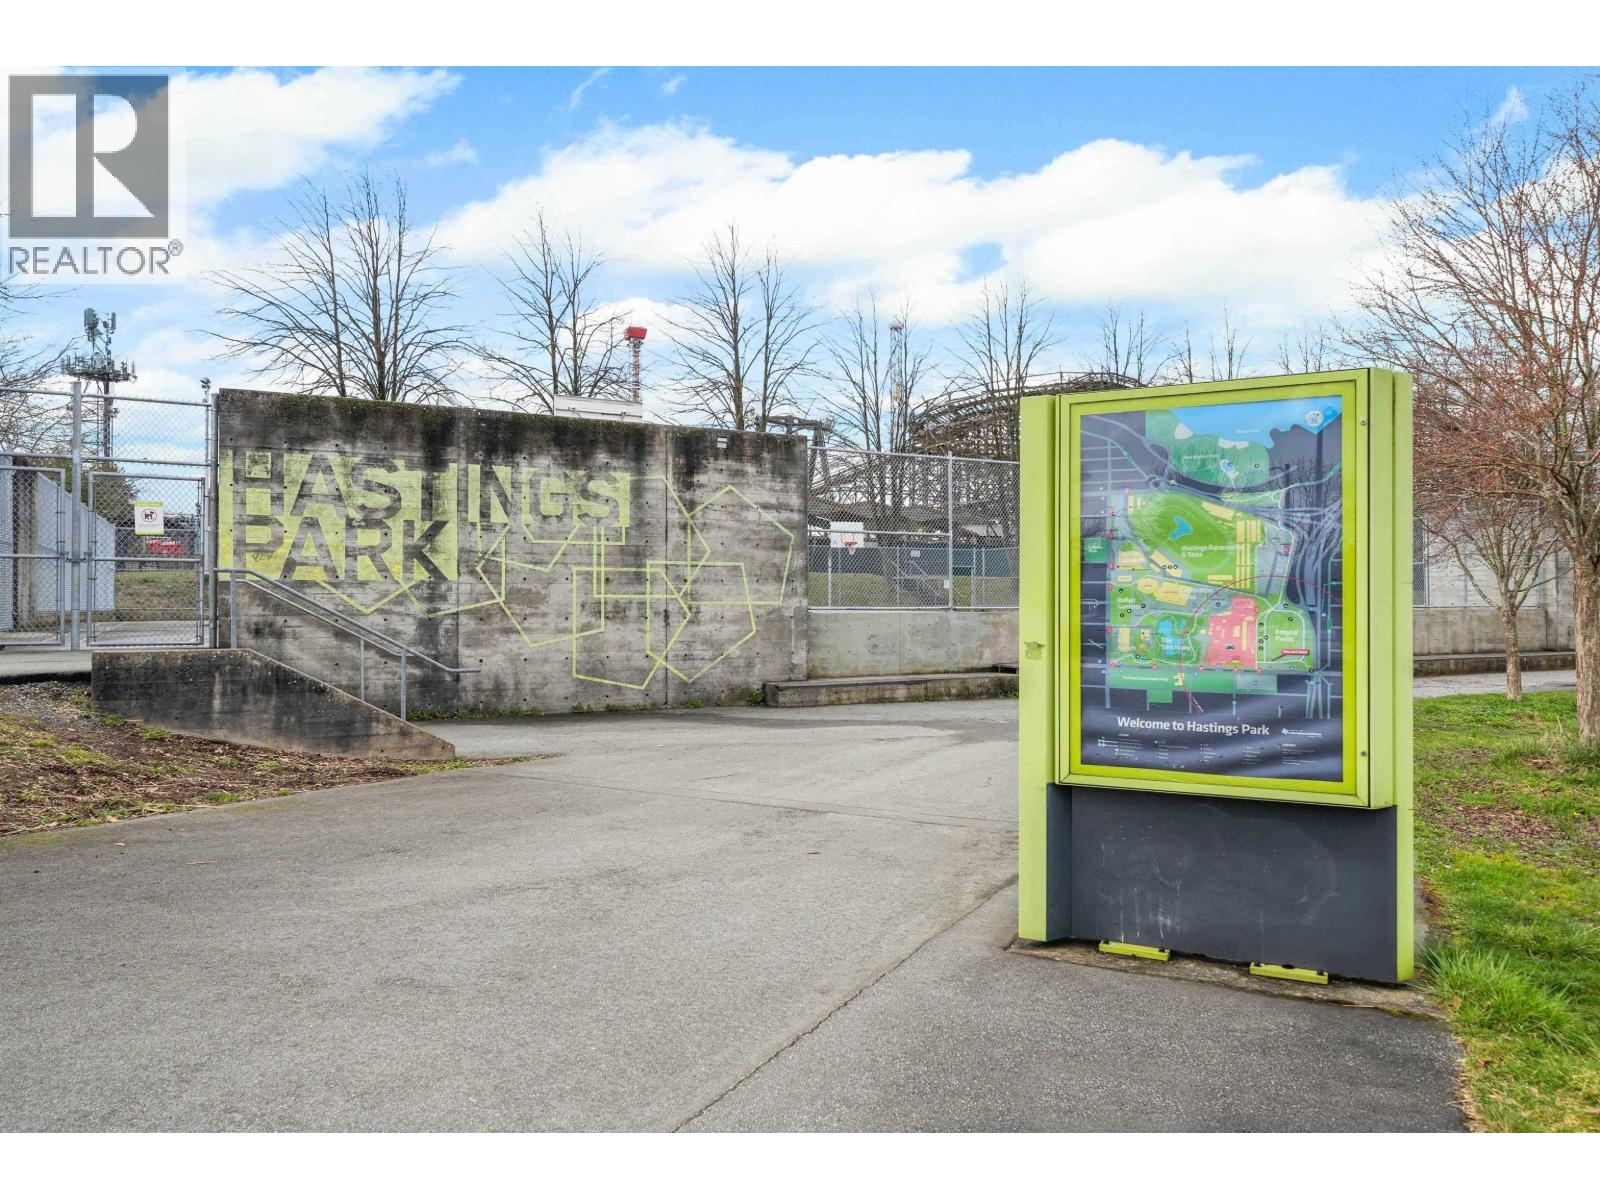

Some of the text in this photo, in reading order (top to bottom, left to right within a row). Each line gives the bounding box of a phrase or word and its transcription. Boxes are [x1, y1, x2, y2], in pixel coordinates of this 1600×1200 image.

[226, 450, 628, 526] HASTINGS
[231, 513, 450, 581] PARK
[1117, 716, 1170, 730] Welcome
[1172, 720, 1184, 731] to
[1187, 721, 1239, 736] Hastings
[1241, 723, 1270, 736] Park
